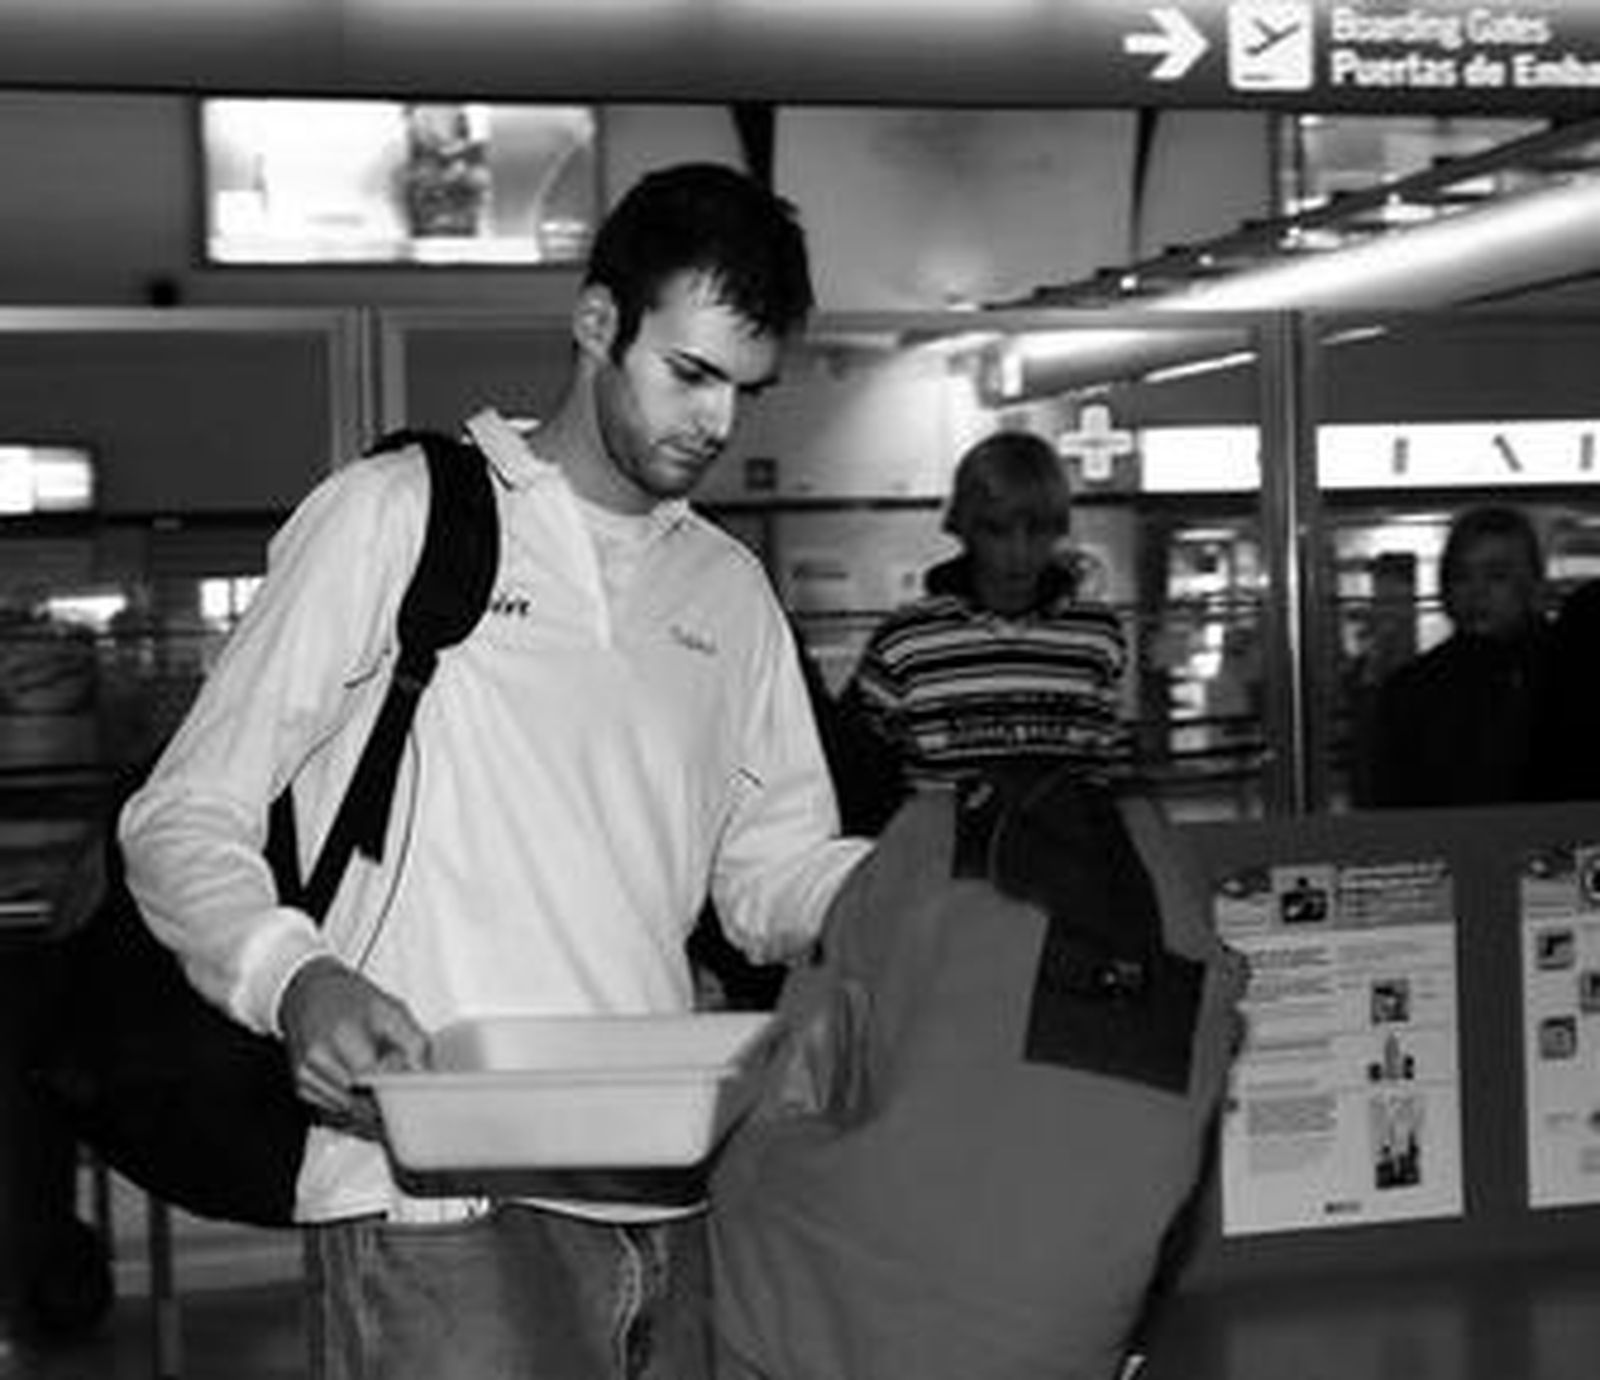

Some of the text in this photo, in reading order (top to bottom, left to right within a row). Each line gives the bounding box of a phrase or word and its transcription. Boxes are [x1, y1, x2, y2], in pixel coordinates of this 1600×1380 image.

[1331, 8, 1551, 50] Boarding Gates
[1331, 49, 1456, 86] Puertas
[1464, 54, 1506, 86] de
